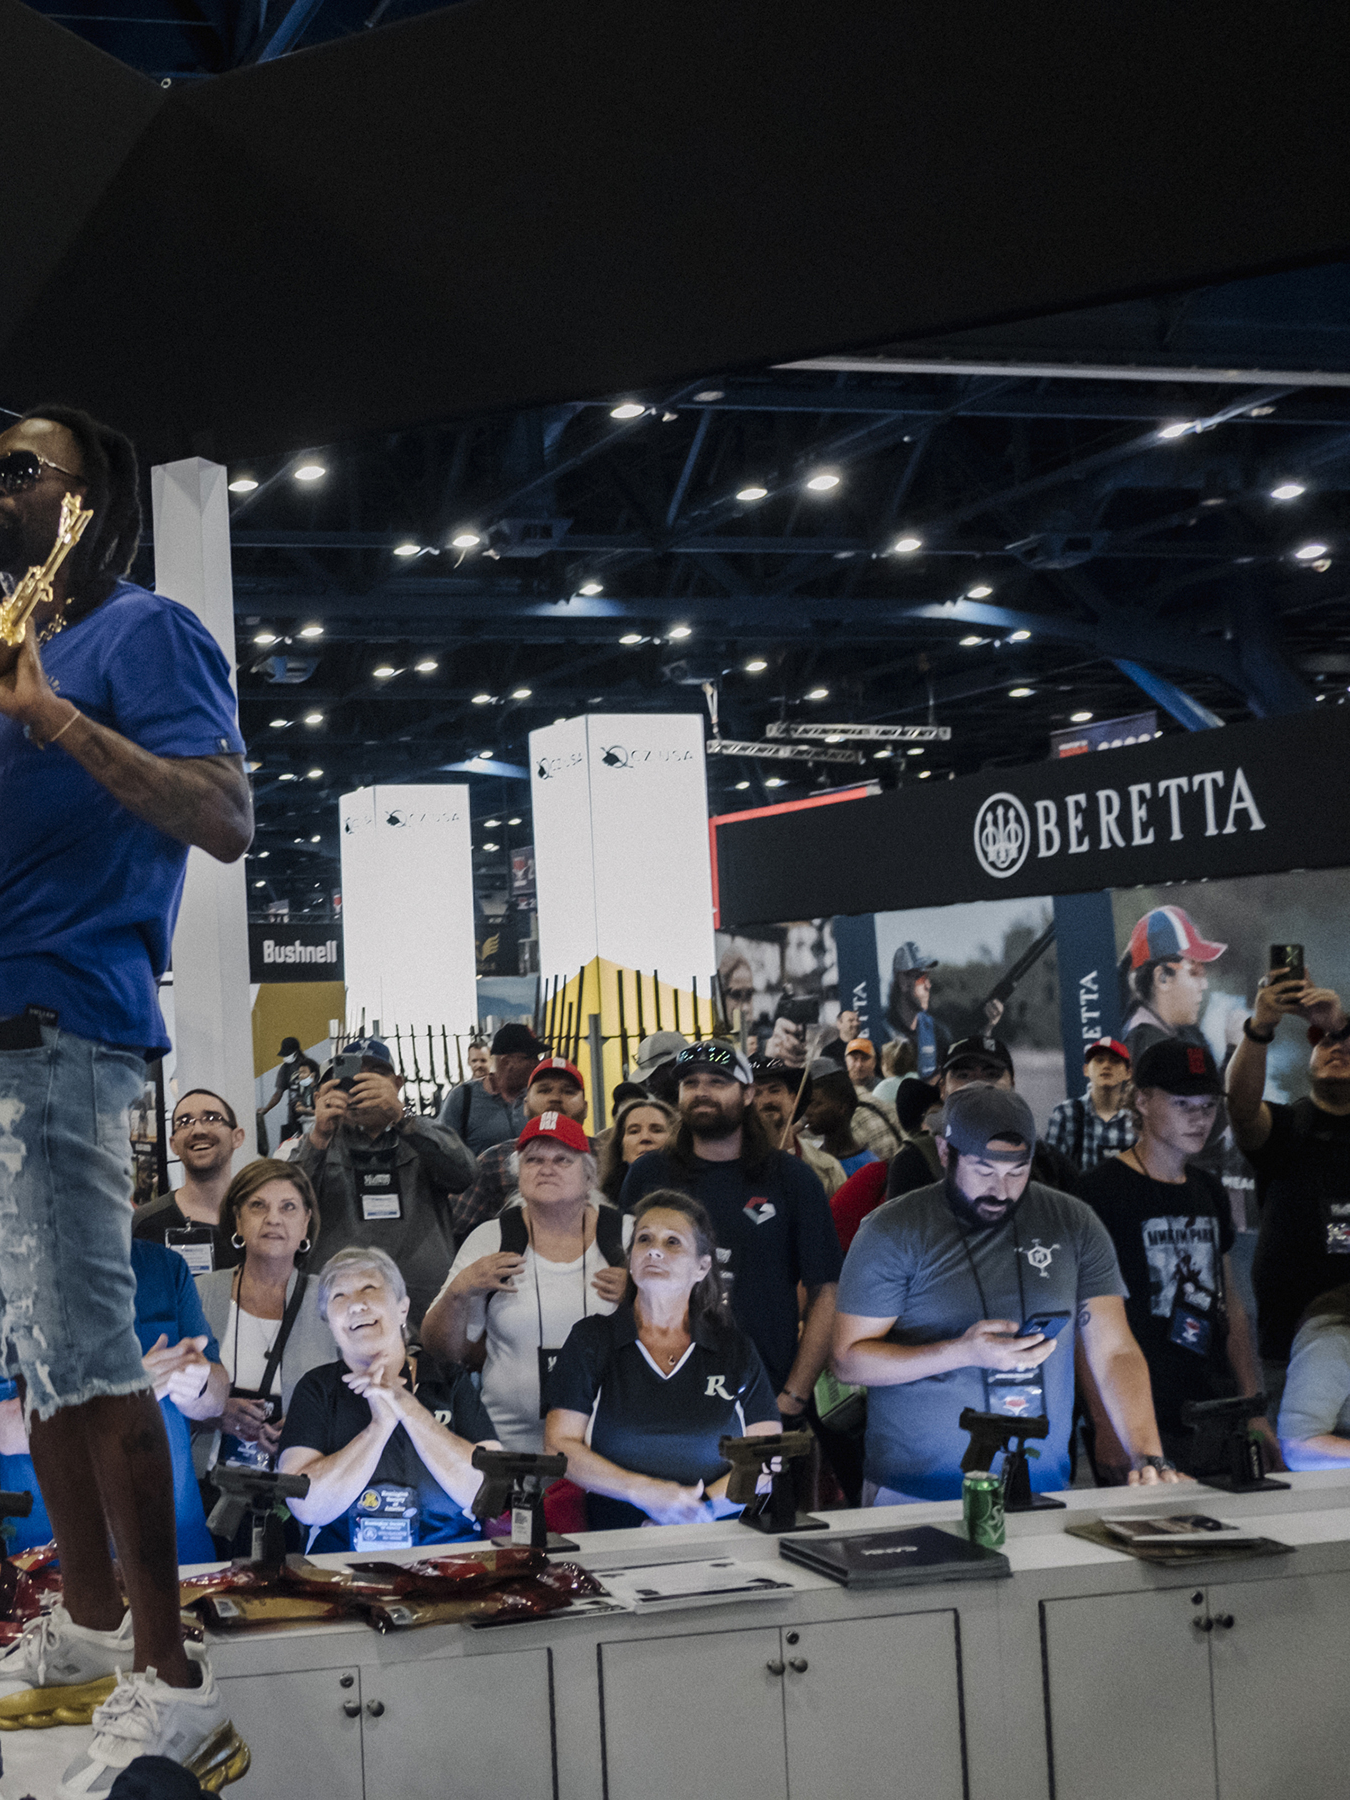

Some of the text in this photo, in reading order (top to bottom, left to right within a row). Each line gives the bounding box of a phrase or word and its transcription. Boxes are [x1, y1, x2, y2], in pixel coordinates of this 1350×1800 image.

[1034, 766, 1266, 858] BERETTA
[262, 939, 338, 964] Bushnell
[704, 1374, 735, 1401] R
